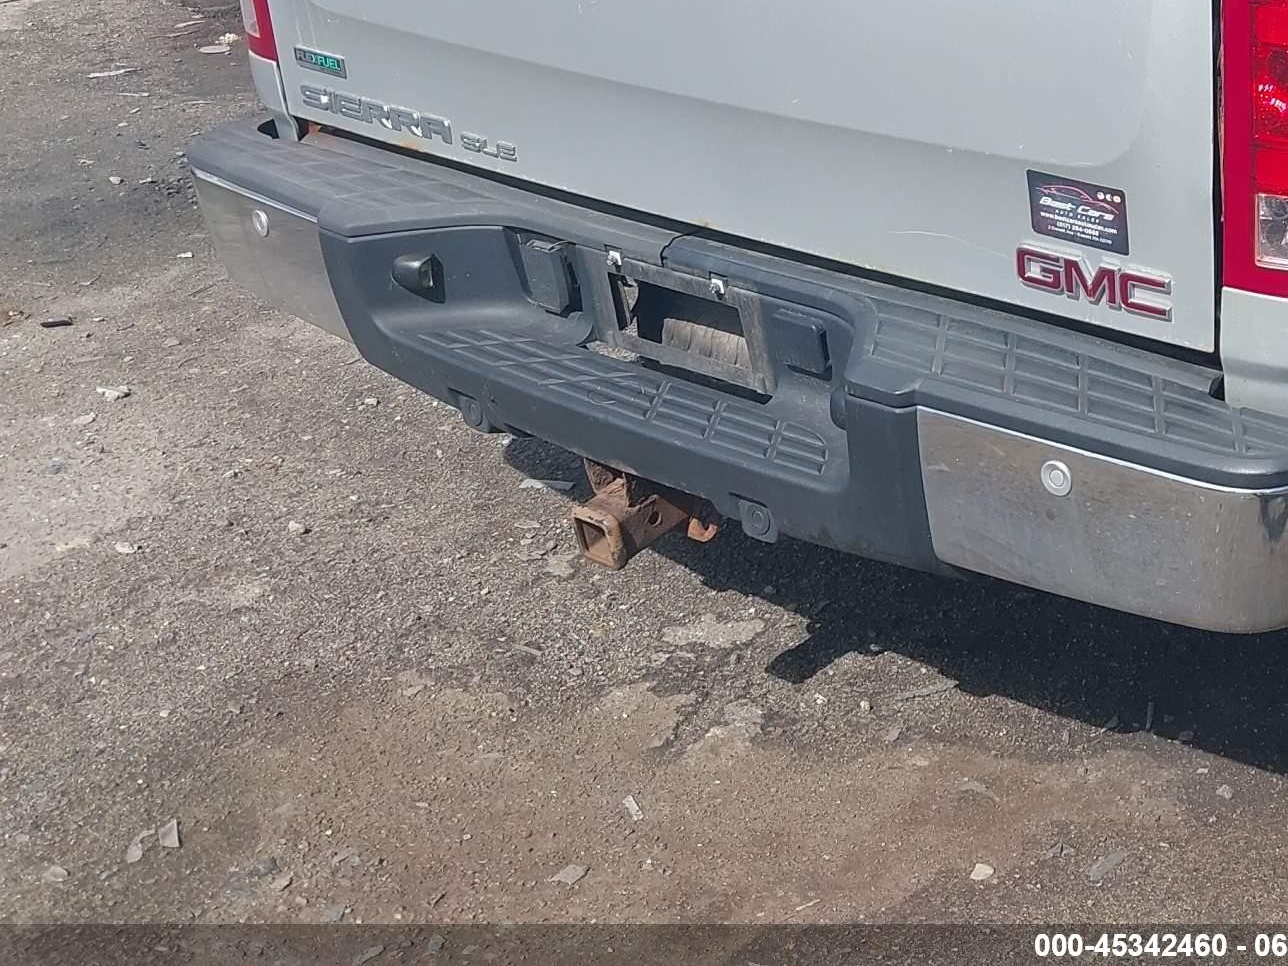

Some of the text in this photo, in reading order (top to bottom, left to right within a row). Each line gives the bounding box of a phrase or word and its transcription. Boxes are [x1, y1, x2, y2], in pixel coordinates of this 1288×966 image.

[300, 83, 518, 162] SIERRA SLE
[1039, 196, 1115, 221] Best Cars
[1016, 243, 1173, 322] GMC
